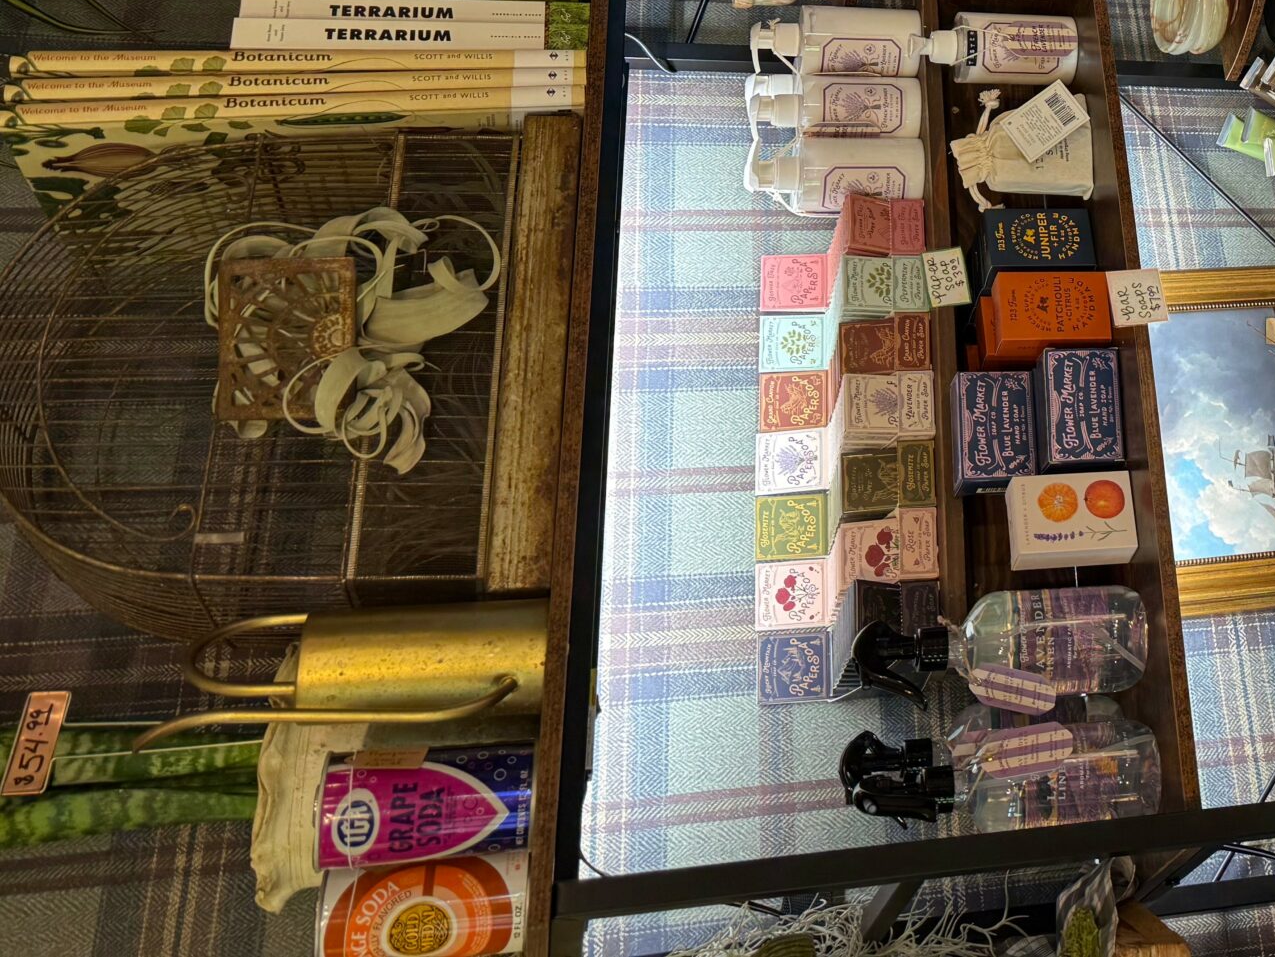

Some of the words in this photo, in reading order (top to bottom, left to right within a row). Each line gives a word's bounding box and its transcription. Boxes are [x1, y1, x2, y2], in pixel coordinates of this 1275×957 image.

[329, 4, 454, 19] TERRARIUM
[325, 28, 452, 42] TERRARIUM
[1031, 25, 1040, 51] FRENCH
[33, 54, 79, 62] Welcome
[112, 54, 157, 62] Museum
[231, 50, 333, 62] Botanicum
[446, 52, 461, 60] and
[464, 52, 493, 60] WILLIS
[227, 75, 330, 87] Botanicum
[412, 74, 442, 82] SCOTT
[996, 222, 1005, 239] Farm
[997, 239, 1006, 251] 123
[1037, 212, 1051, 260] JUNIPER
[900, 262, 910, 303] PEPPERMINT
[1053, 276, 1065, 333] PATCHOULI
[767, 380, 775, 404] CANYON
[1060, 359, 1076, 404] MARKET
[1089, 370, 1098, 414] LAVENDER
[766, 405, 776, 424] GRAND
[973, 380, 988, 422] MARKET
[1002, 390, 1012, 432] LAVENDER
[975, 425, 991, 466] FLOWER
[1002, 434, 1014, 456] BLUE
[1062, 407, 1080, 449] FLOWER
[1090, 416, 1101, 439] BLUE
[761, 510, 770, 547] YOSEMITE
[905, 530, 915, 553] ROSE
[923, 520, 931, 537] SOAP
[13, 704, 53, 786] $54.99
[341, 805, 371, 843] IGA
[389, 783, 417, 853] GRAPE
[416, 787, 445, 846] SODA
[372, 890, 412, 930] FLAVORED
[405, 913, 419, 950] GOLD
[421, 909, 435, 951] MEDAL
